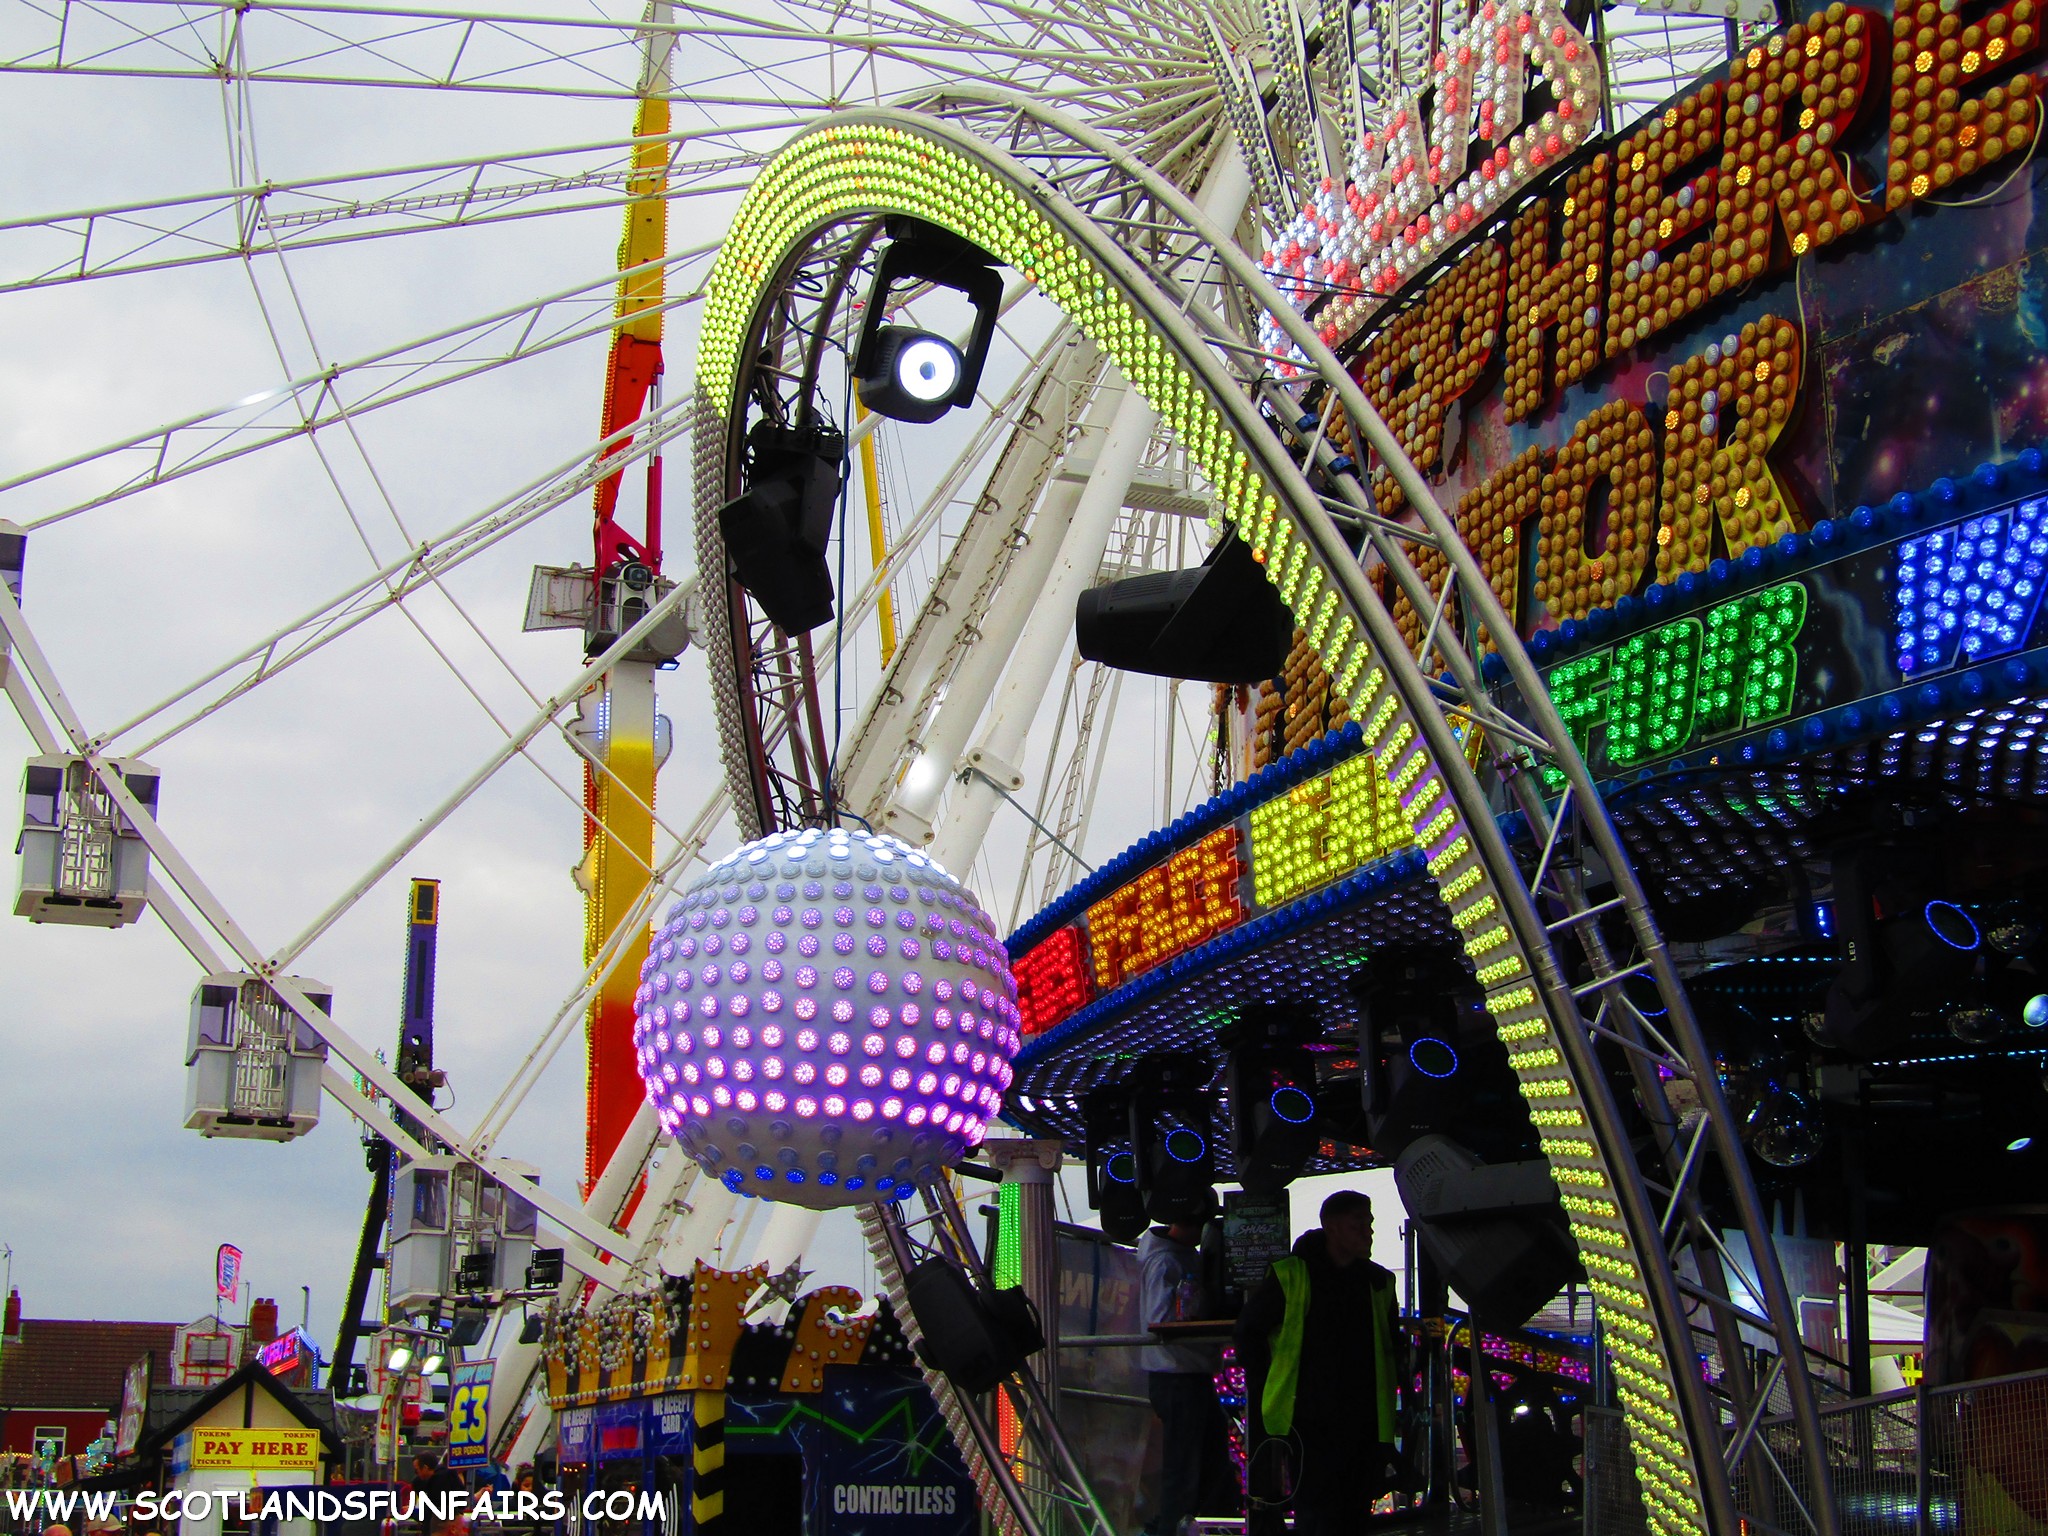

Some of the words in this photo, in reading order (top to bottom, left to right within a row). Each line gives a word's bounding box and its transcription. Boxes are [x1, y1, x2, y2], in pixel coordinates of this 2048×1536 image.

[1542, 580, 1808, 792] FOR
[1849, 941, 1857, 962] LED
[450, 1384, 490, 1444] £3
[652, 1397, 664, 1416] WE
[663, 1393, 691, 1415] ACCEPT
[571, 1407, 593, 1427] ACCEPT
[661, 1413, 681, 1435] CARD
[569, 1426, 585, 1444] CARD
[204, 1441, 243, 1455] PAY
[251, 1442, 309, 1456] HERE
[451, 1446, 463, 1456] PER
[463, 1445, 485, 1455] PERSON
[834, 1483, 956, 1515] CONTACTLESS
